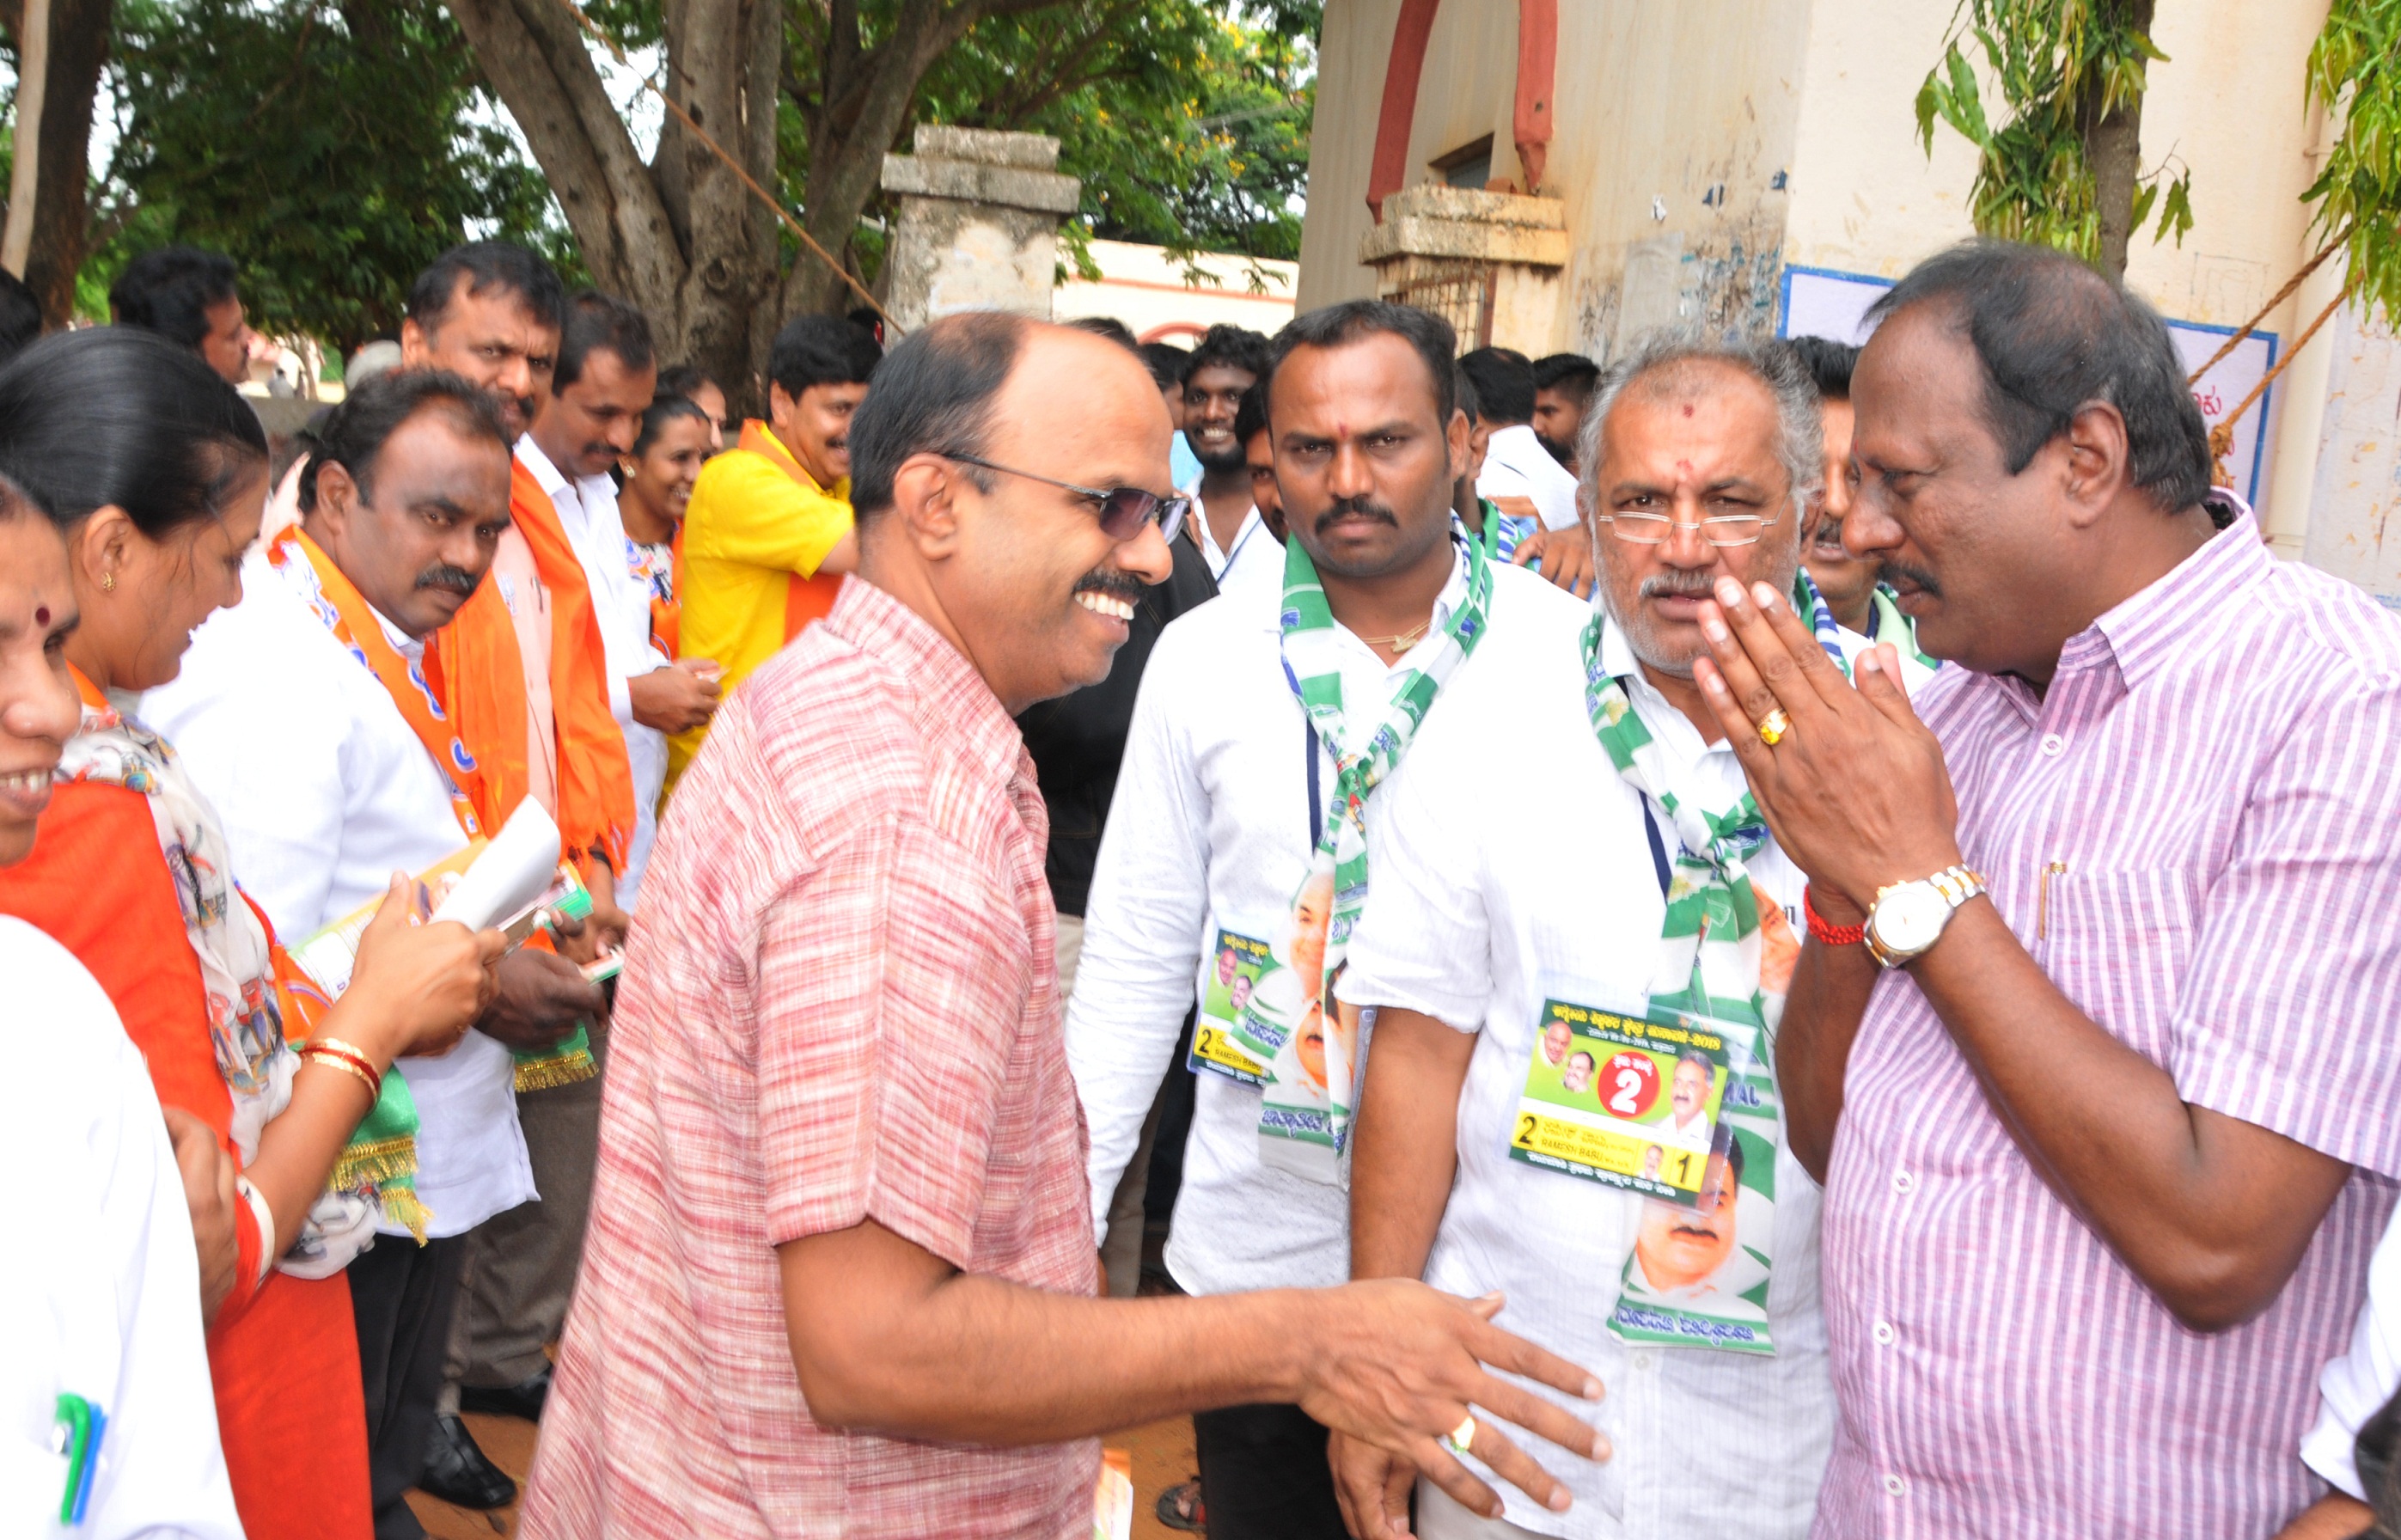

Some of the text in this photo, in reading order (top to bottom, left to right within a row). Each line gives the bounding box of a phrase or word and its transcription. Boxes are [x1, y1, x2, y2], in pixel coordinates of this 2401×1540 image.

[1199, 1029, 1212, 1055] 2
[1215, 1048, 1242, 1064] RAMESH
[1609, 1068, 1642, 1115] 2
[1518, 1115, 1538, 1145] 2
[1541, 1139, 1578, 1156] RAMESH
[1678, 1154, 1691, 1184] 1
